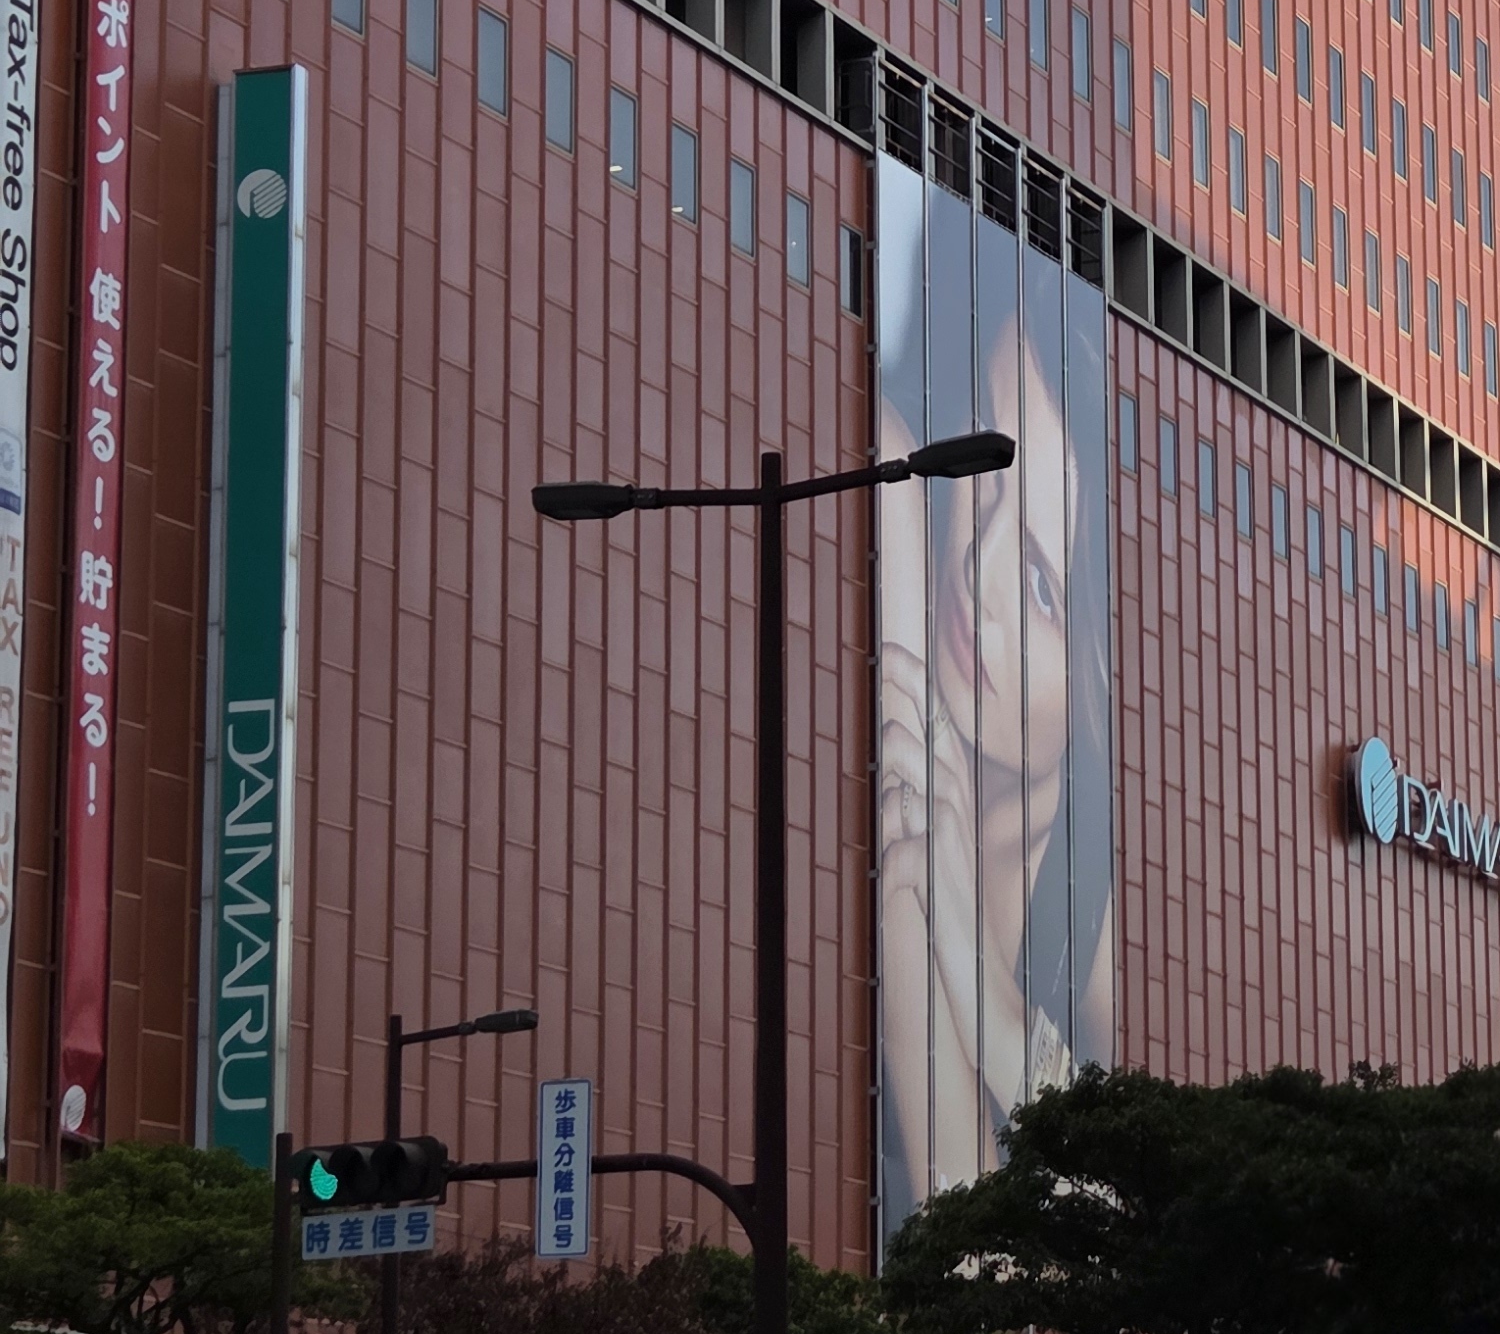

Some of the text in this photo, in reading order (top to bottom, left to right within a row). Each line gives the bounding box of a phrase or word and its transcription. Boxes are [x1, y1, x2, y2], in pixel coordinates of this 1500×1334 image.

[217, 699, 275, 1110] DAIMARU
[306, 1212, 430, 1254] 時差信号
[553, 1088, 577, 1249] 歩車分離信号
